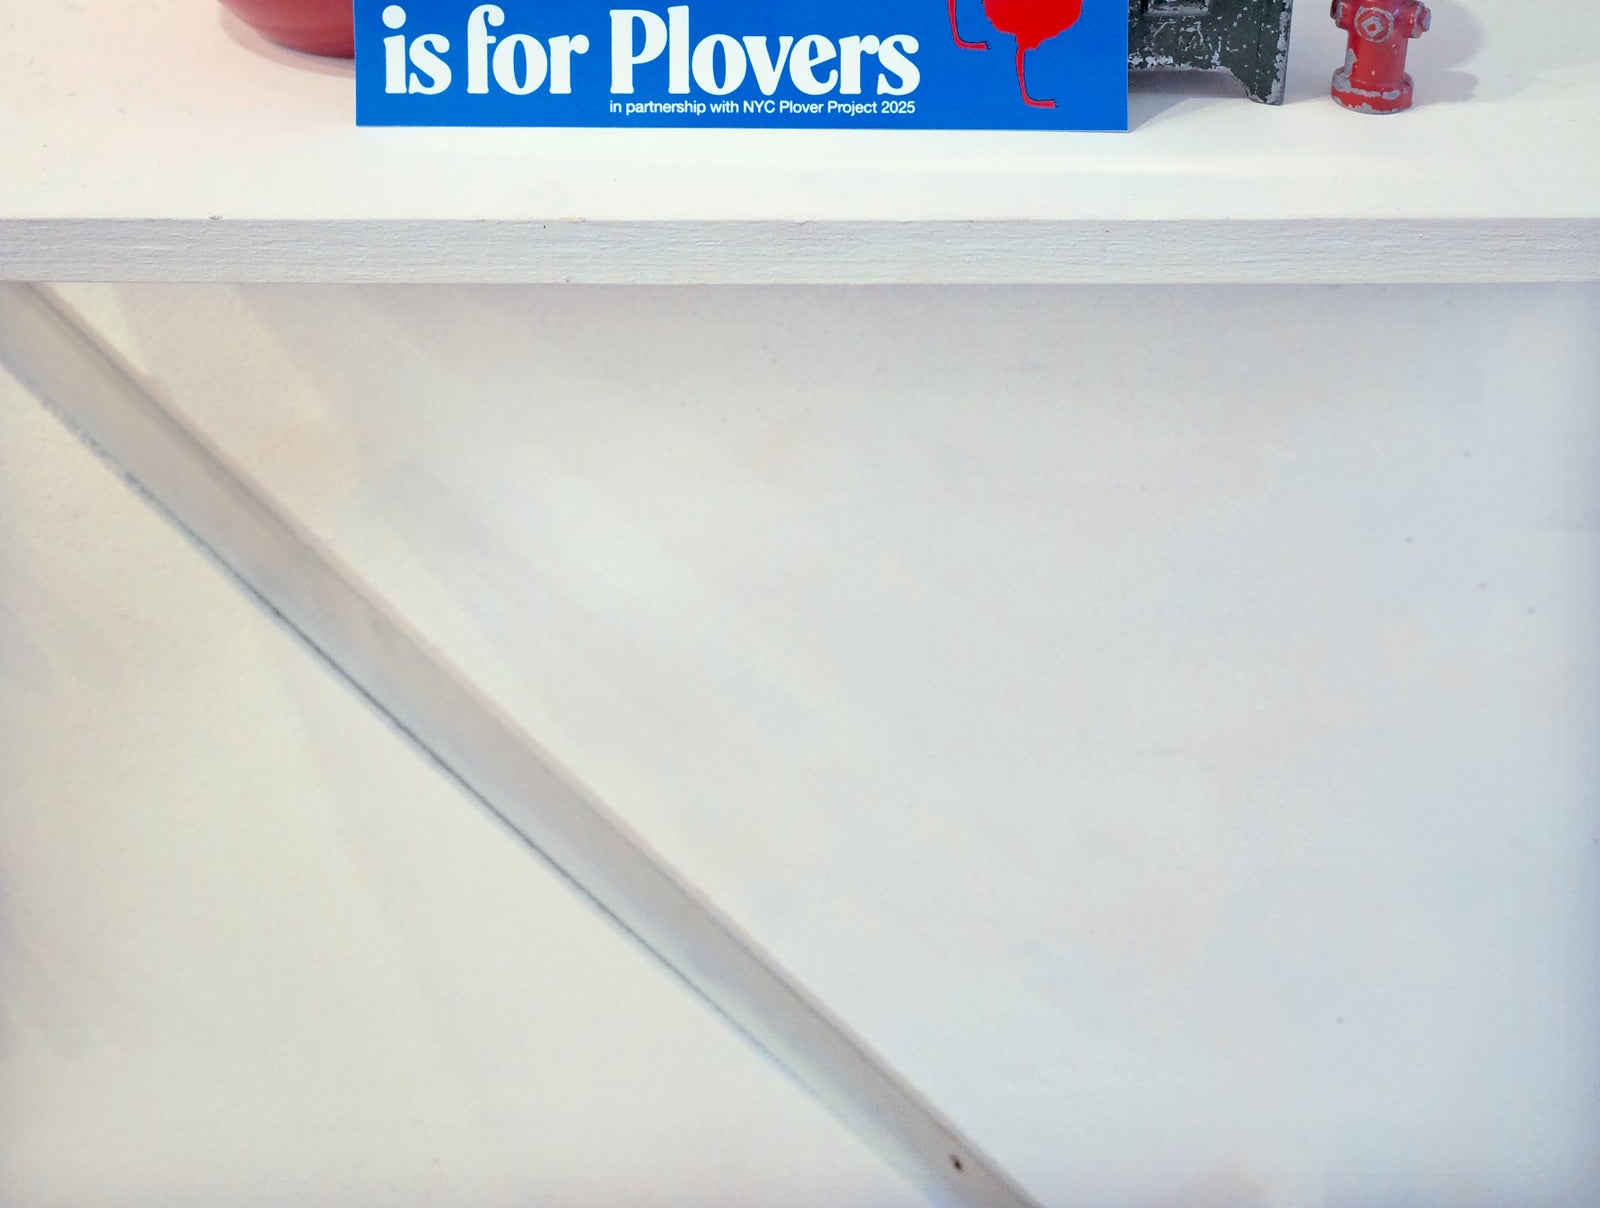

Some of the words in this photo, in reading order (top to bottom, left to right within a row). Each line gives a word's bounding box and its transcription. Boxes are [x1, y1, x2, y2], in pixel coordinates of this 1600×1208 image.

[381, 4, 452, 95] is
[466, 4, 590, 95] for
[609, 5, 921, 96] Plovers
[609, 100, 622, 113] in
[625, 100, 707, 117] partnership
[709, 100, 739, 113] with
[743, 99, 776, 113] NYC
[779, 100, 824, 114] Plover
[827, 100, 878, 117] Project
[881, 100, 916, 114] 2025
